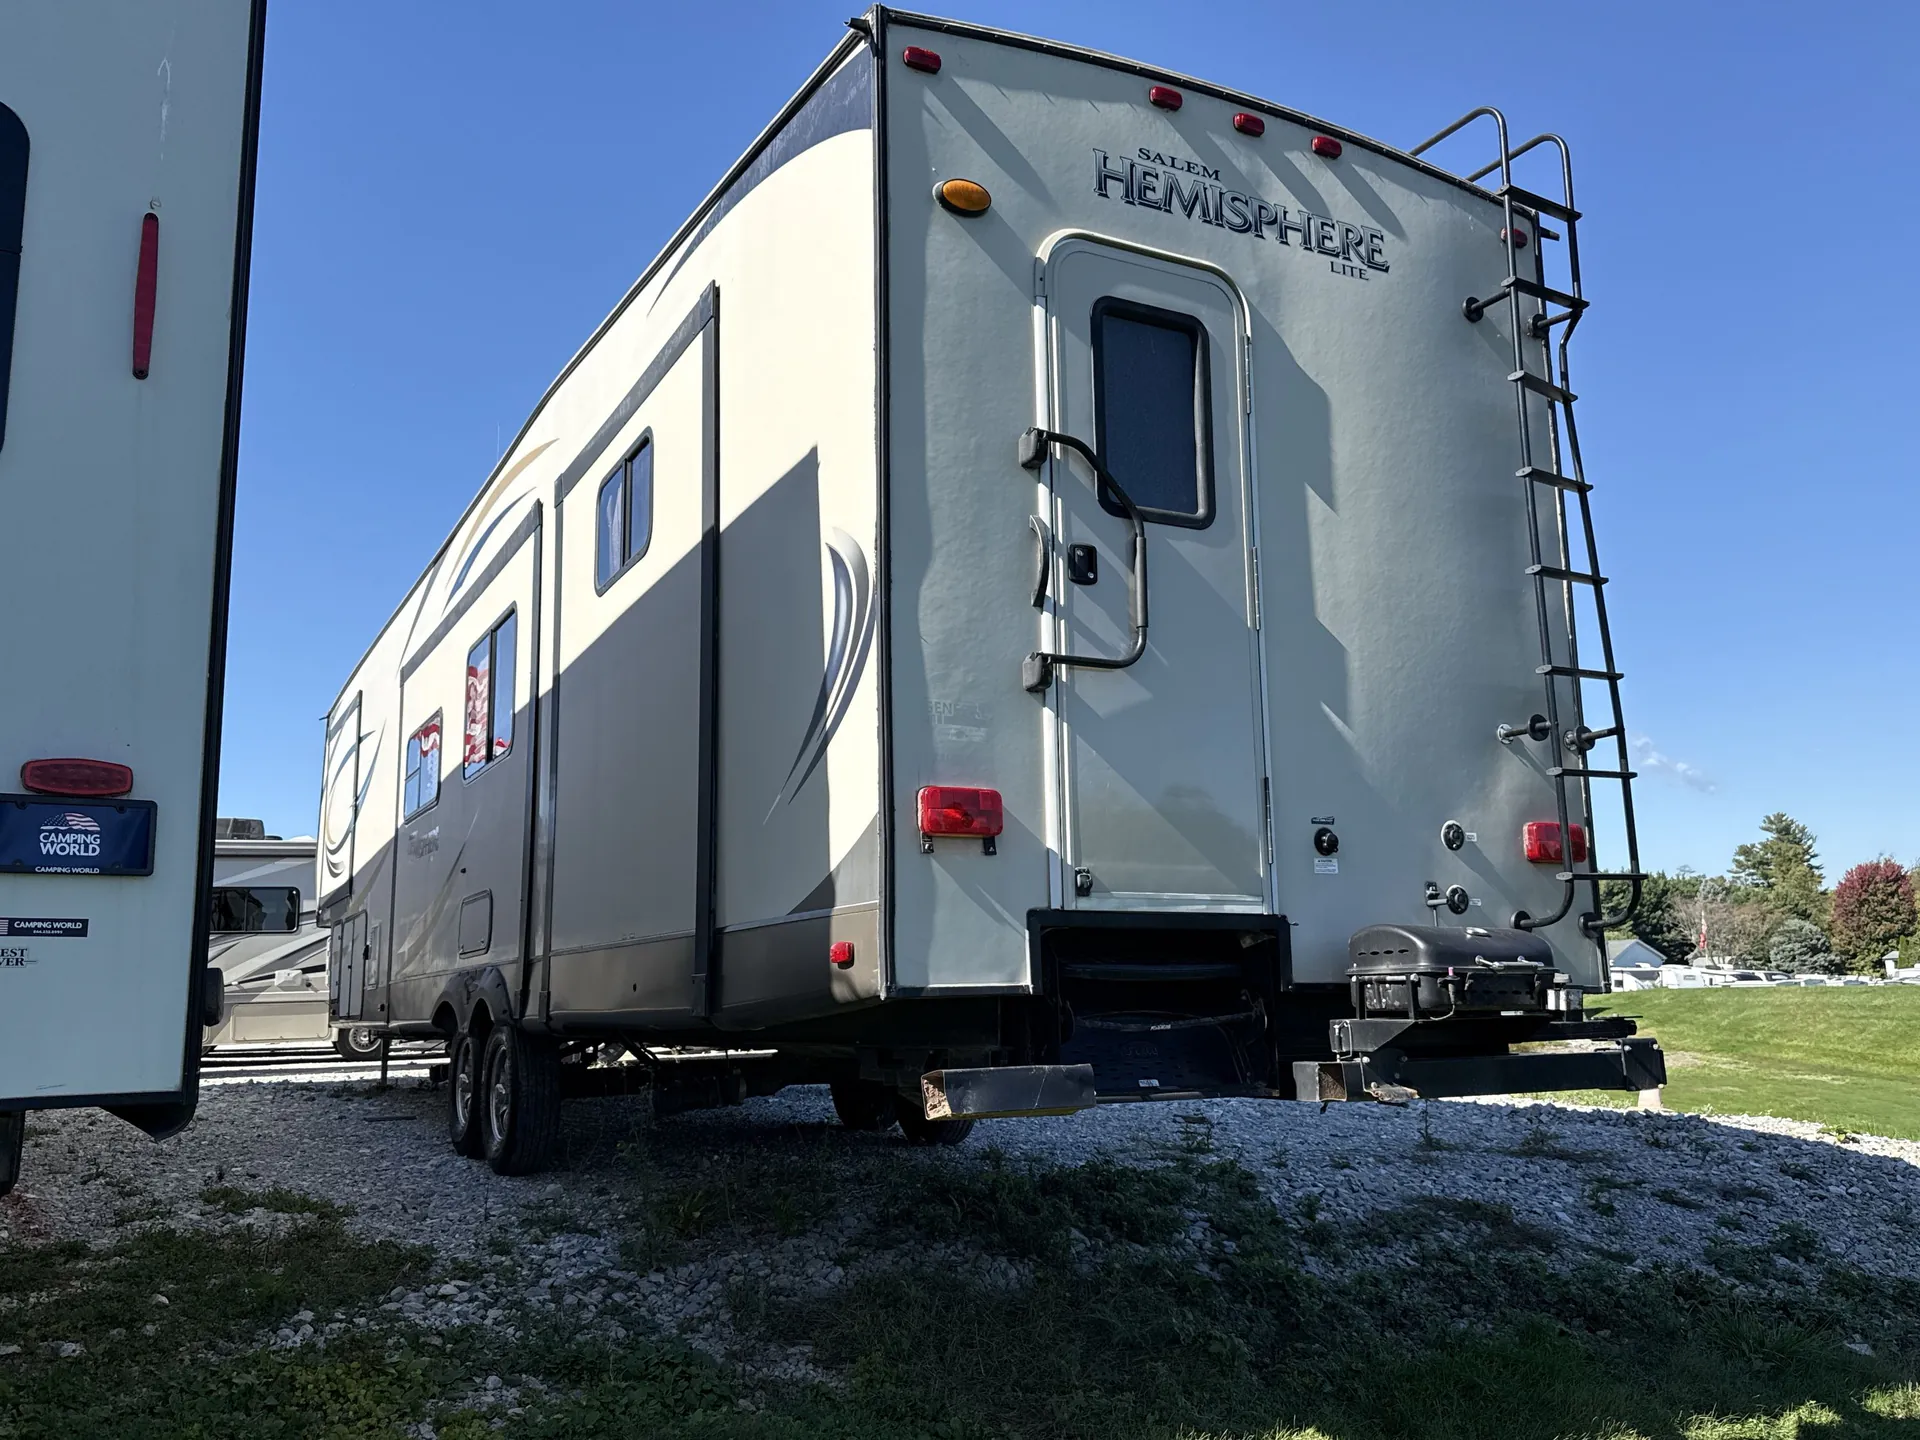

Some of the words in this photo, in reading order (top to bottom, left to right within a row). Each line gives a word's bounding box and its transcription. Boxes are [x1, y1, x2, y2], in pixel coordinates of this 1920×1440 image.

[1138, 147, 1220, 181] SALEM
[1092, 148, 1390, 273] HEMISPHERE
[1330, 261, 1369, 281] LITE
[39, 832, 101, 845] CAMPING
[40, 842, 100, 856] WORLD
[14, 921, 52, 929] CAMPING
